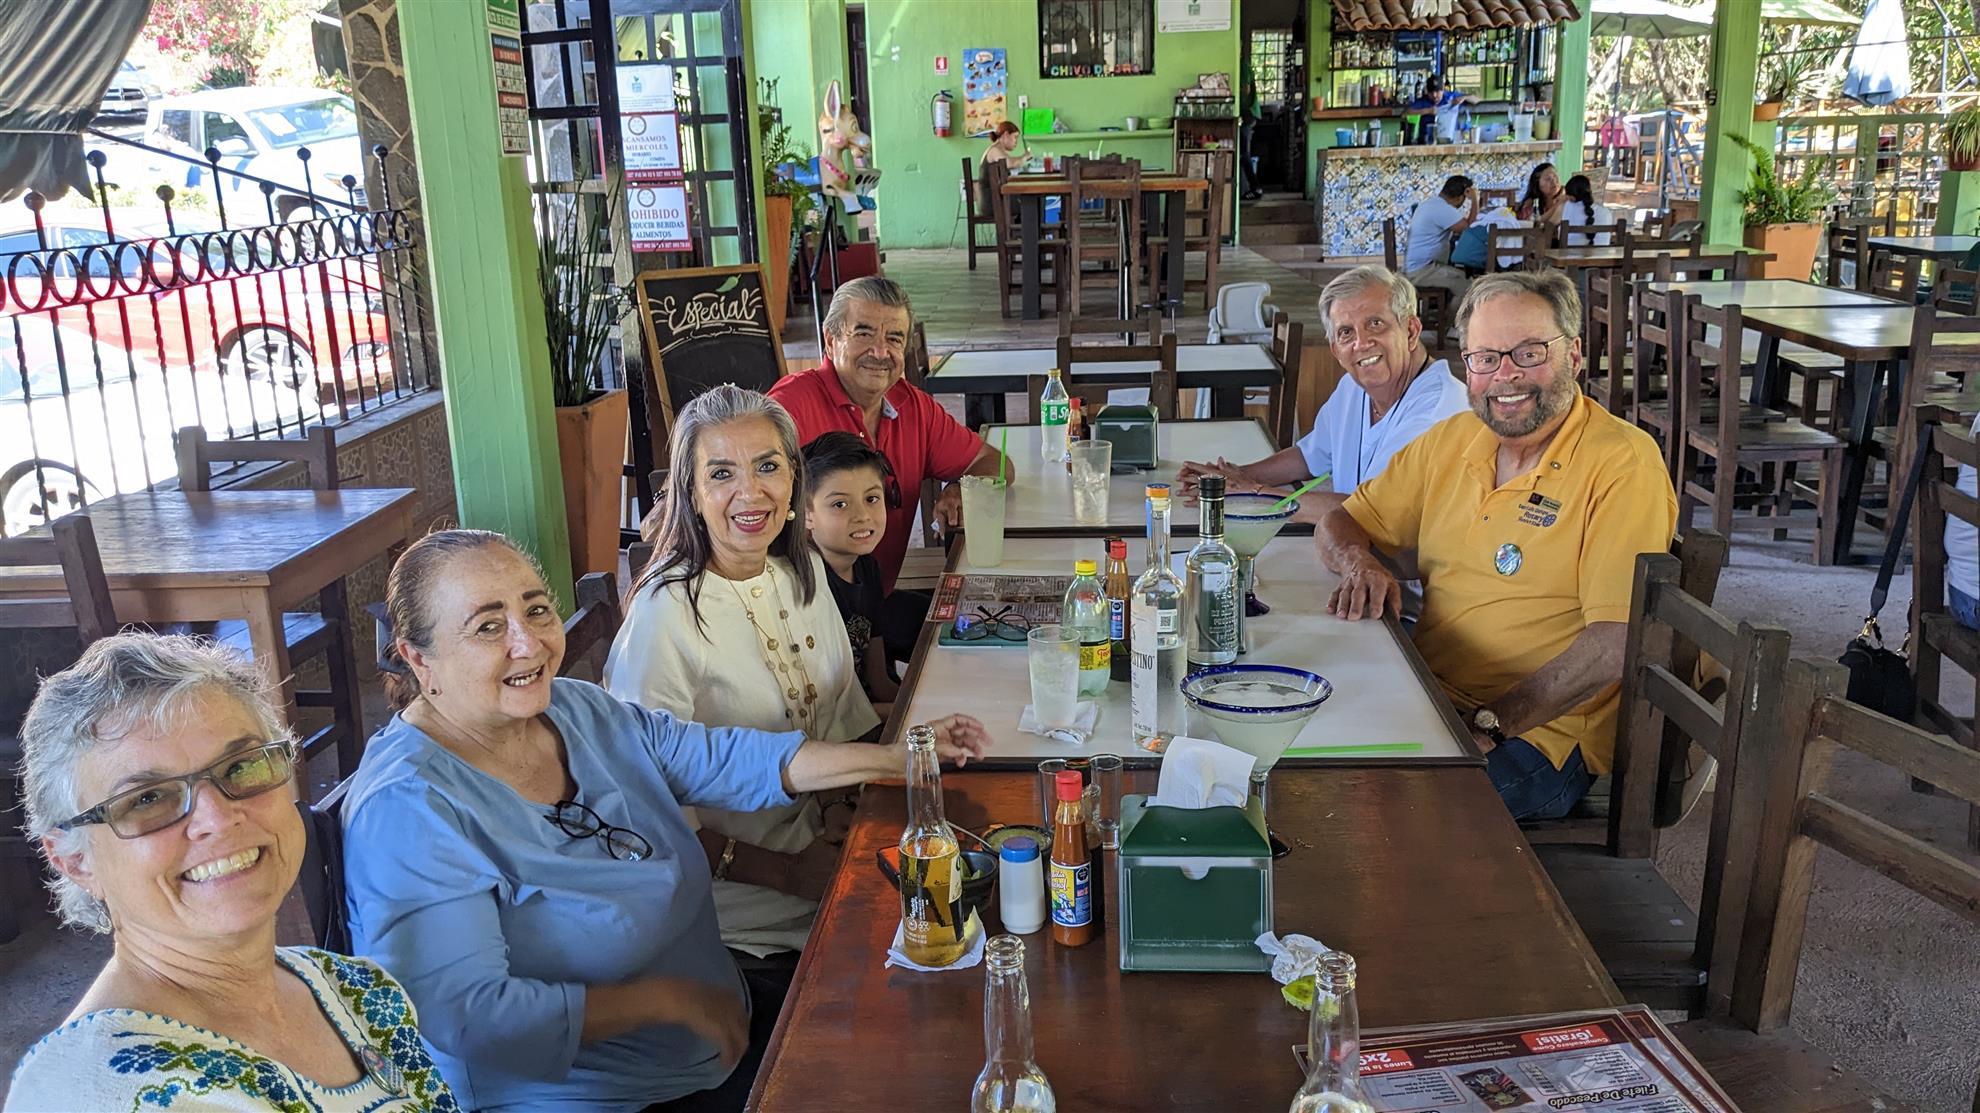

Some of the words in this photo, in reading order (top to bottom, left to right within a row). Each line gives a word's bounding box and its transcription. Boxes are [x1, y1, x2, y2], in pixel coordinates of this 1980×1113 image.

[623, 135, 667, 143] CANSAMOS
[631, 208, 680, 220] OHIBIDO
[656, 221, 685, 229] BEBIDAS
[636, 231, 673, 239] ALIMENTOS
[664, 289, 756, 331] Especial
[1524, 511, 1543, 523] Rotary
[1132, 650, 1153, 670] TINO
[1536, 1029, 1593, 1046] ¡Gratis!
[1384, 1060, 1413, 1068] Lunes
[1602, 1089, 1622, 1102] De
[1622, 1084, 1659, 1098] Filete
[1548, 1093, 1601, 1109] Pescado
